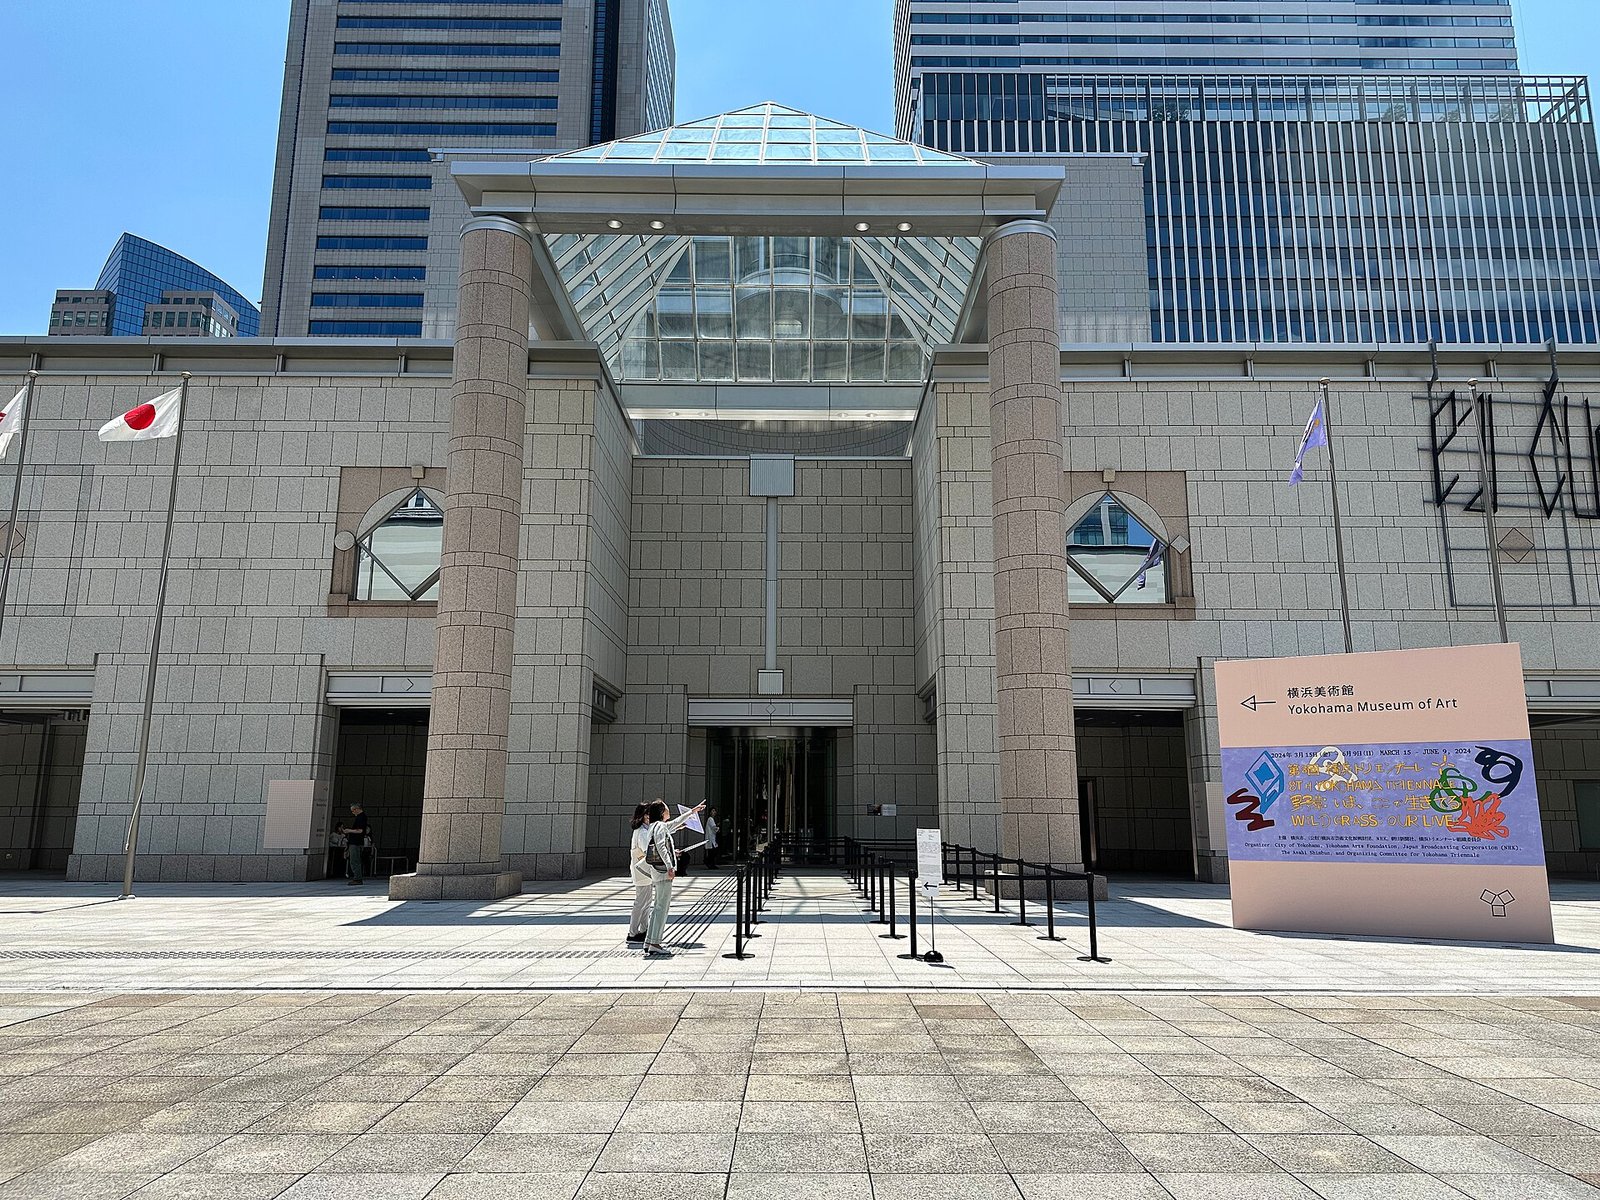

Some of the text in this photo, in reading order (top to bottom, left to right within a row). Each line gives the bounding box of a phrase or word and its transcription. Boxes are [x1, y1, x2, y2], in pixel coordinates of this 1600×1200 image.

[1287, 684, 1354, 699] 横浜美術館
[1288, 698, 1458, 715] Yokohama Museum of Art
[1442, 748, 1451, 756] 9,
[1388, 813, 1418, 828] OUR
